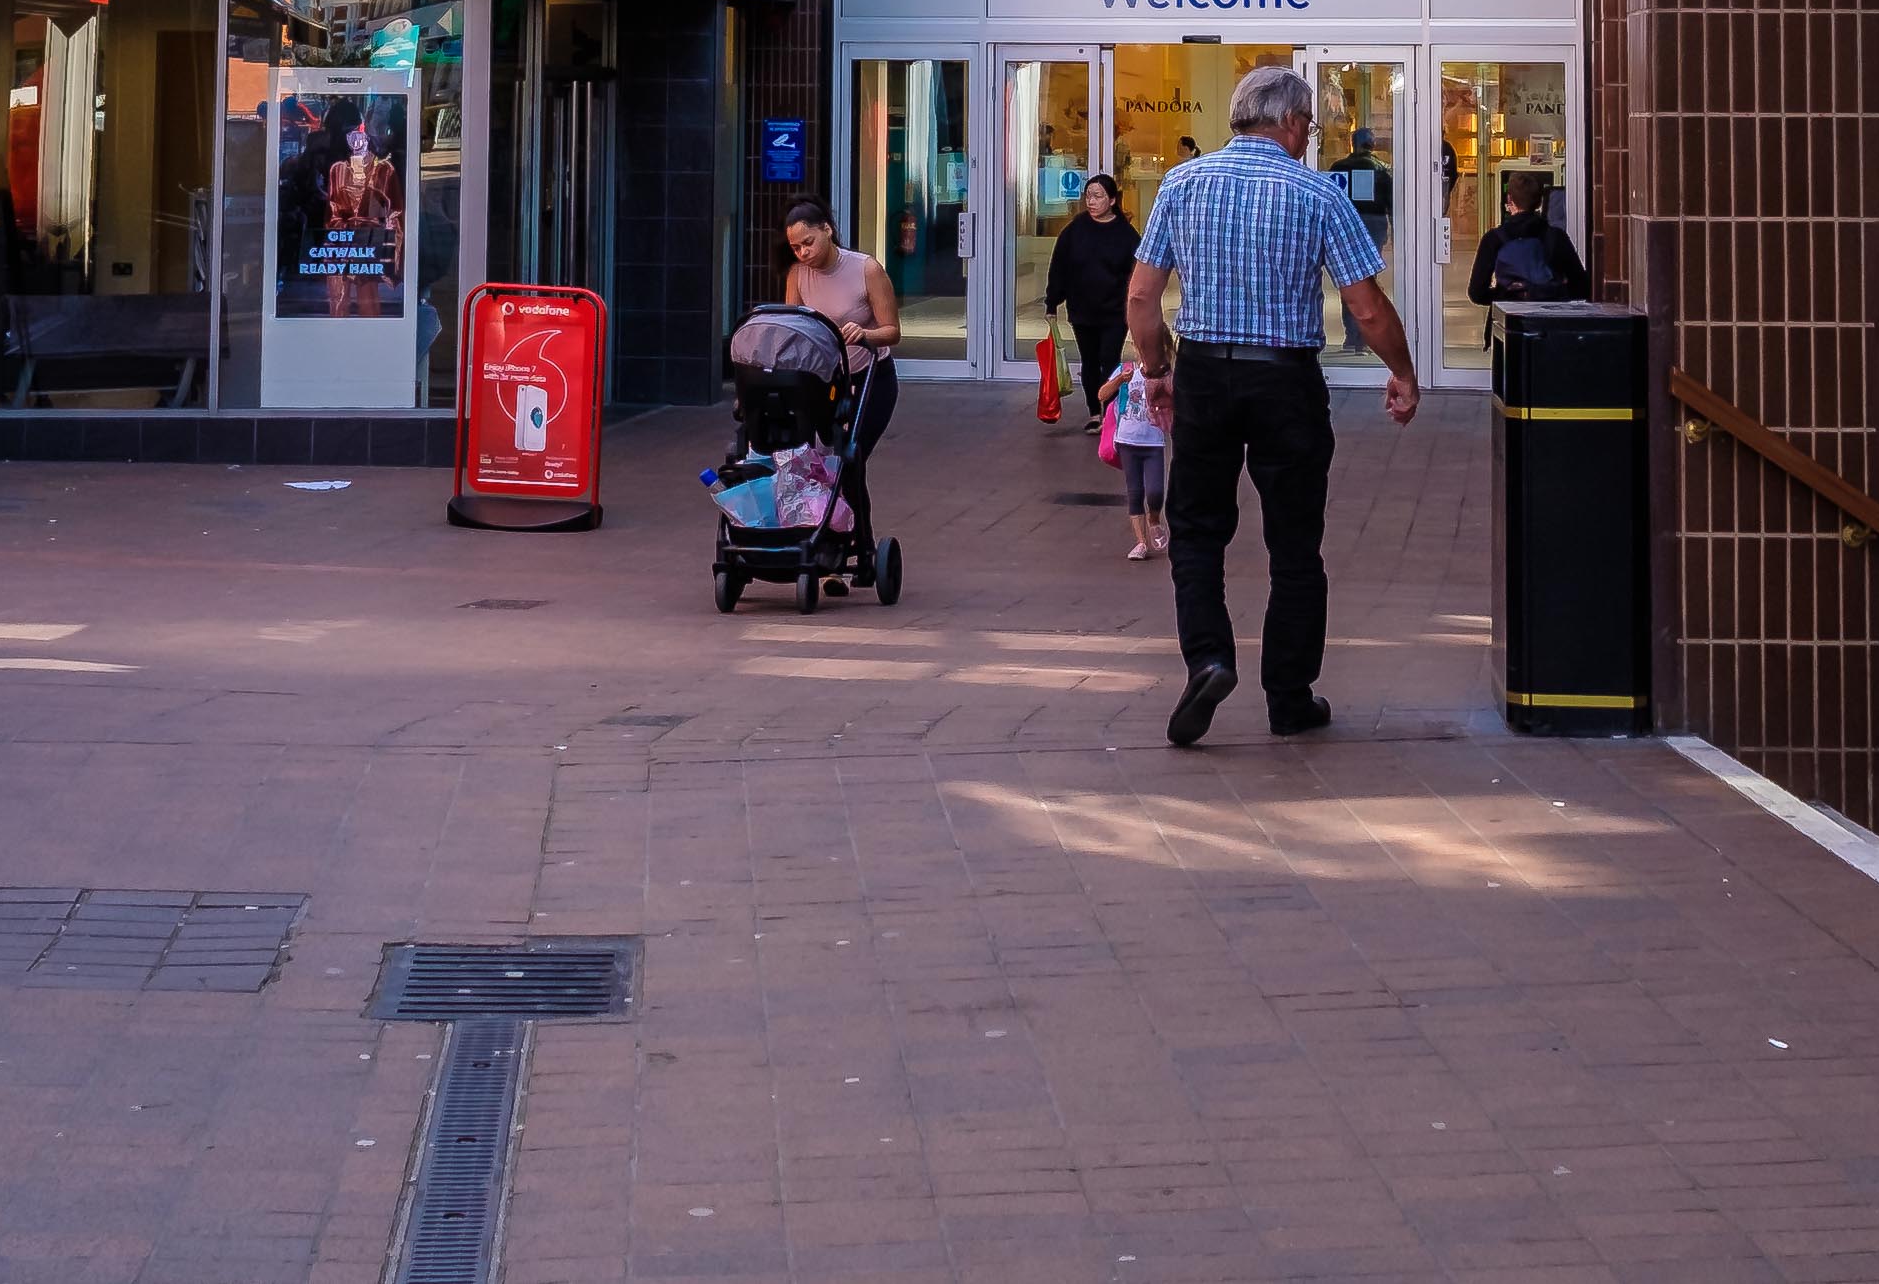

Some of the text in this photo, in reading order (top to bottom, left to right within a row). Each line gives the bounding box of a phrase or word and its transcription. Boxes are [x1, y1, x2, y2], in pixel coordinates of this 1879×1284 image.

[1125, 100, 1203, 113] PANDORA
[327, 230, 355, 242] GET
[309, 247, 376, 259] CATWALK
[299, 263, 385, 275] READY HAIR
[519, 305, 570, 316] vodafone
